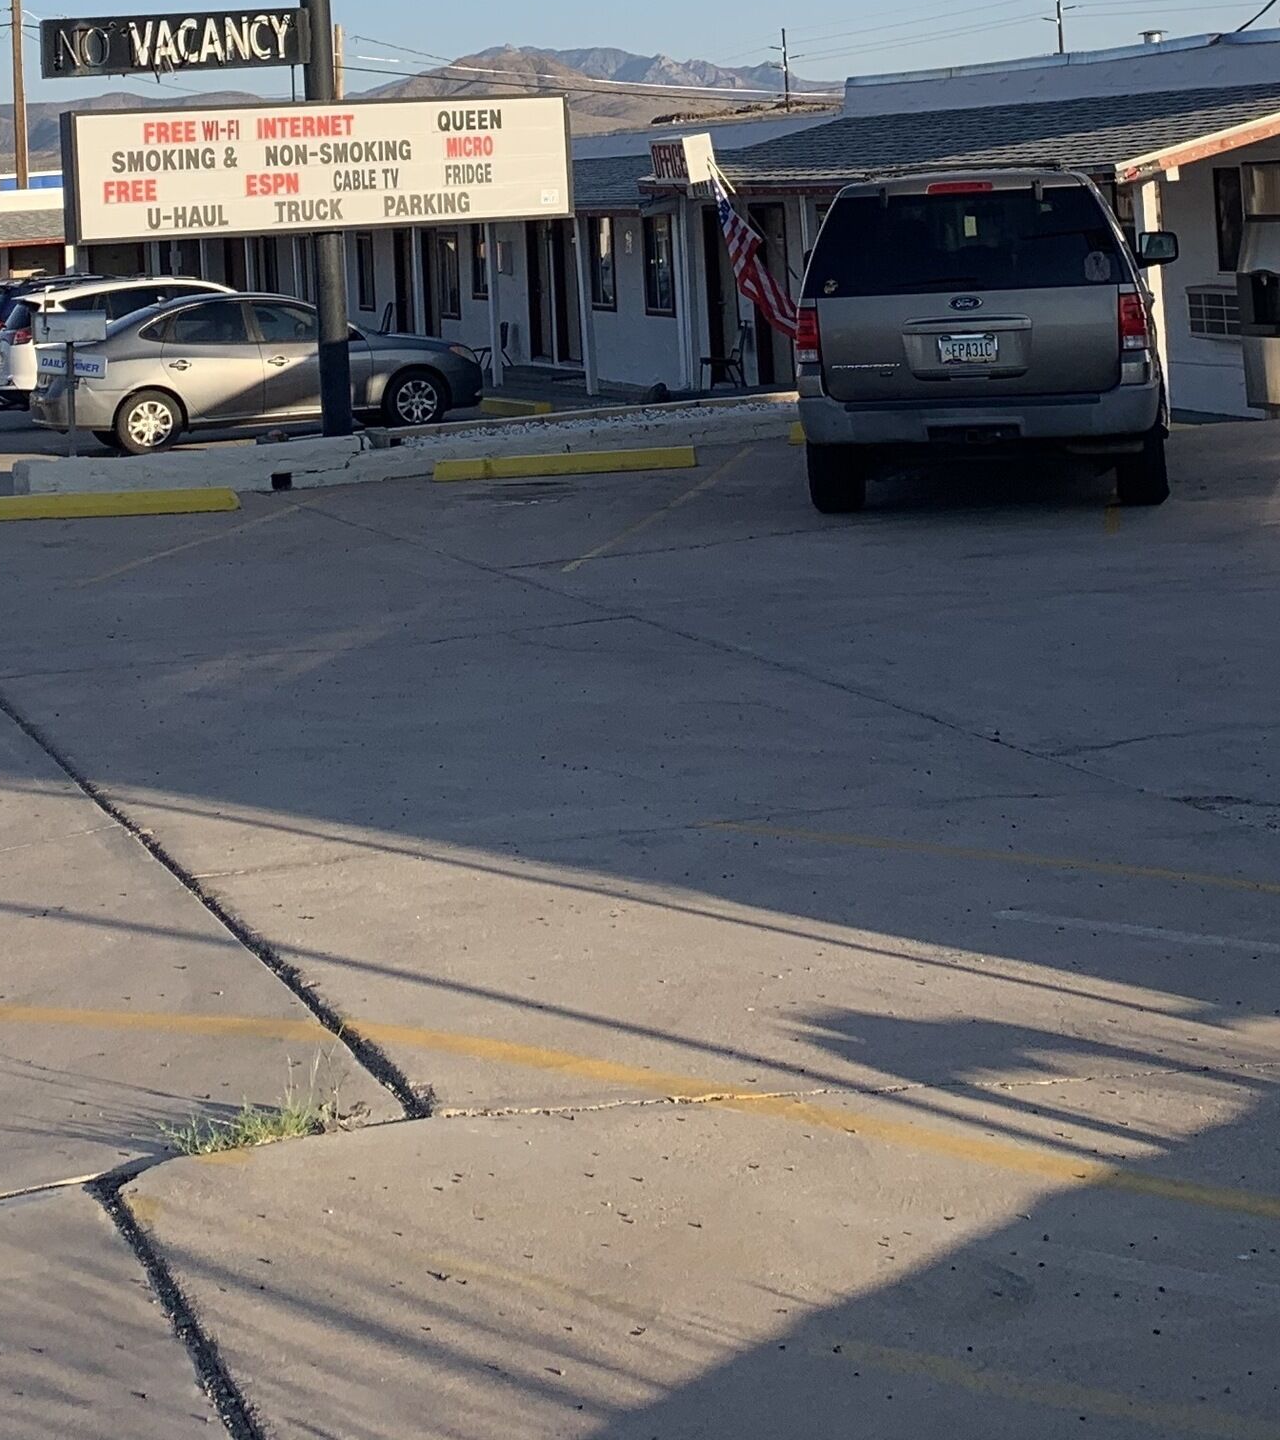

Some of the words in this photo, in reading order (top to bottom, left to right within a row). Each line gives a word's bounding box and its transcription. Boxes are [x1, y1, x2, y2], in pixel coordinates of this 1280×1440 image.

[55, 25, 111, 68] NO
[129, 14, 291, 67] VACANCY
[143, 120, 196, 144] FREE
[201, 119, 240, 142] WI-FI
[256, 114, 355, 140] INTERNET
[437, 109, 502, 132] QUEEN
[111, 147, 216, 173] SMOKING
[223, 146, 238, 168] &
[265, 139, 412, 167] NON-SMOKING
[446, 135, 494, 158] MICRO
[245, 172, 299, 197] ESPN
[333, 168, 377, 192] CABLE
[382, 167, 399, 190] TV
[444, 162, 493, 185] FRIDGE
[103, 179, 157, 204] FREE
[147, 204, 229, 229] U-HAUL
[274, 198, 344, 223] TRUCK
[383, 192, 471, 217] PARKING
[951, 342, 993, 358] EPA31C
[41, 358, 67, 369] DAILY
[74, 361, 100, 373] INER
